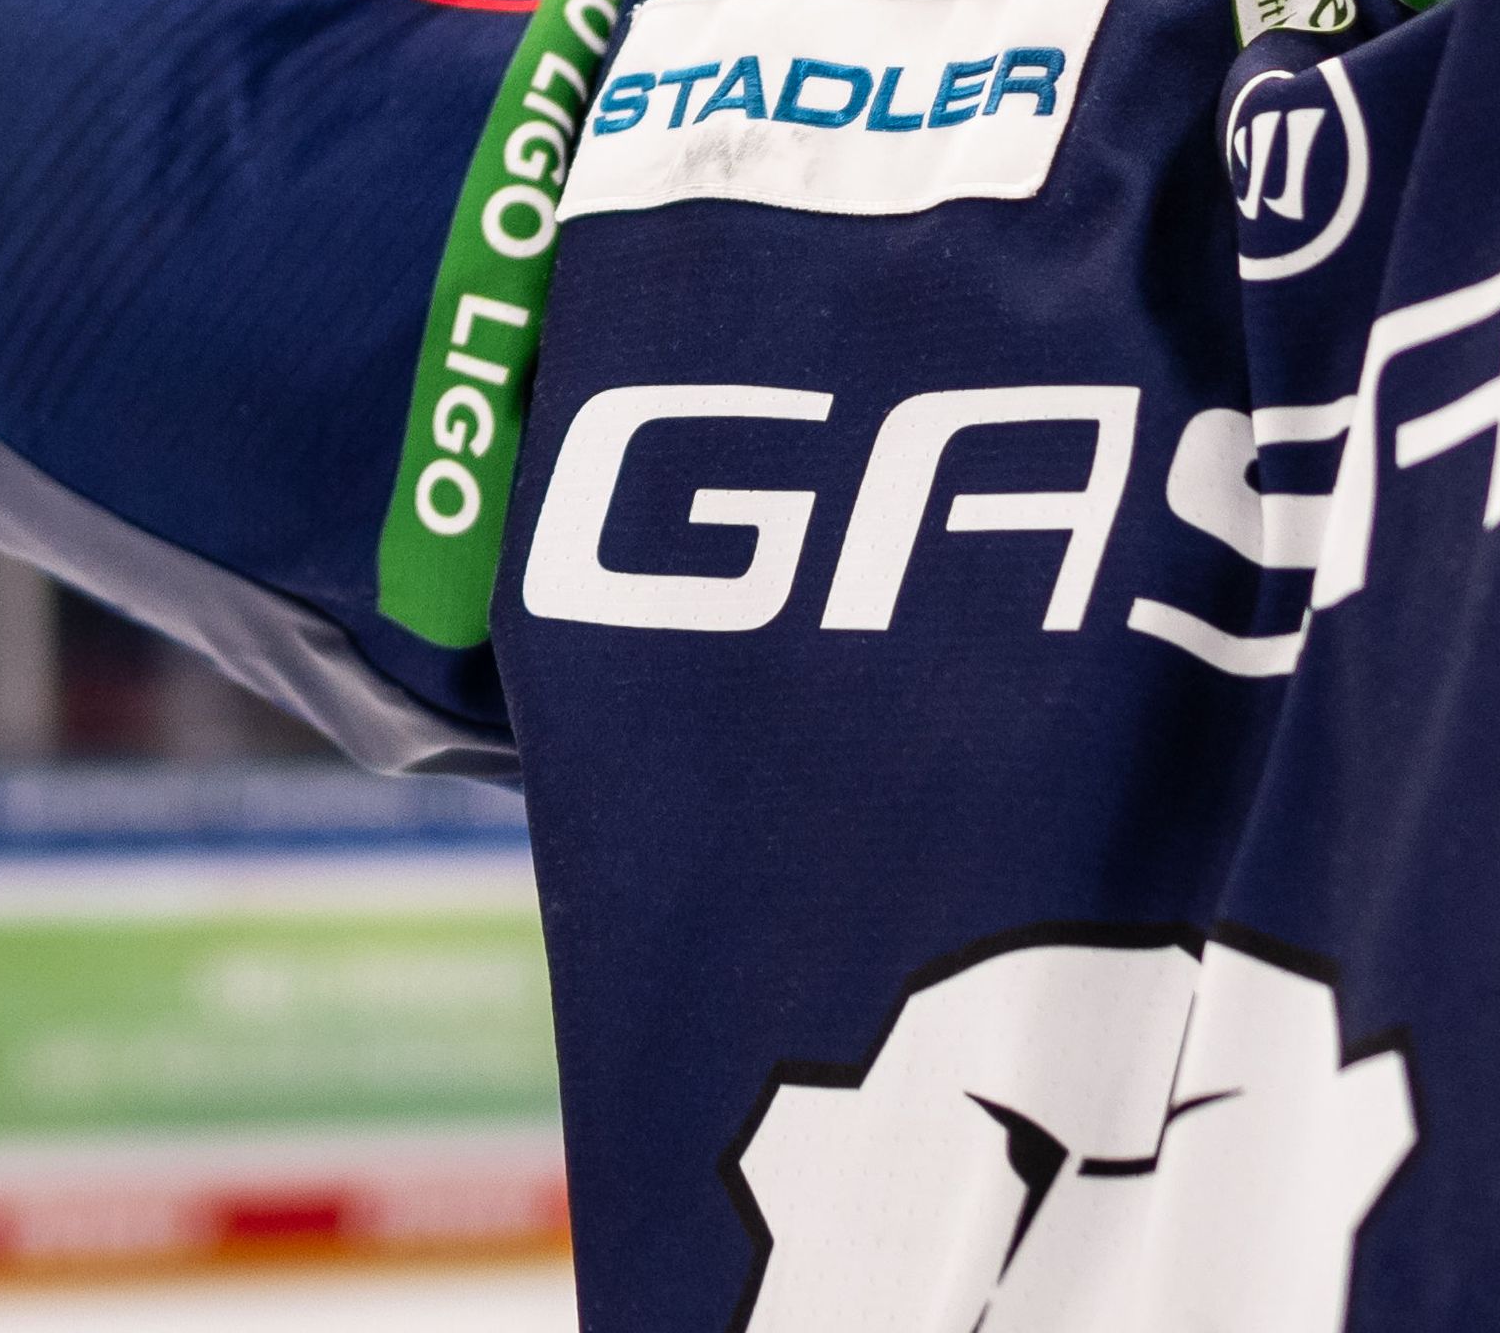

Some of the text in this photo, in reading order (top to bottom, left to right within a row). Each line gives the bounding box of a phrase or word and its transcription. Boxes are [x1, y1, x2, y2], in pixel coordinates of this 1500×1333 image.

[481, 50, 590, 260] LIGO
[592, 41, 1069, 137] STADLER
[414, 292, 530, 536] LIGO
